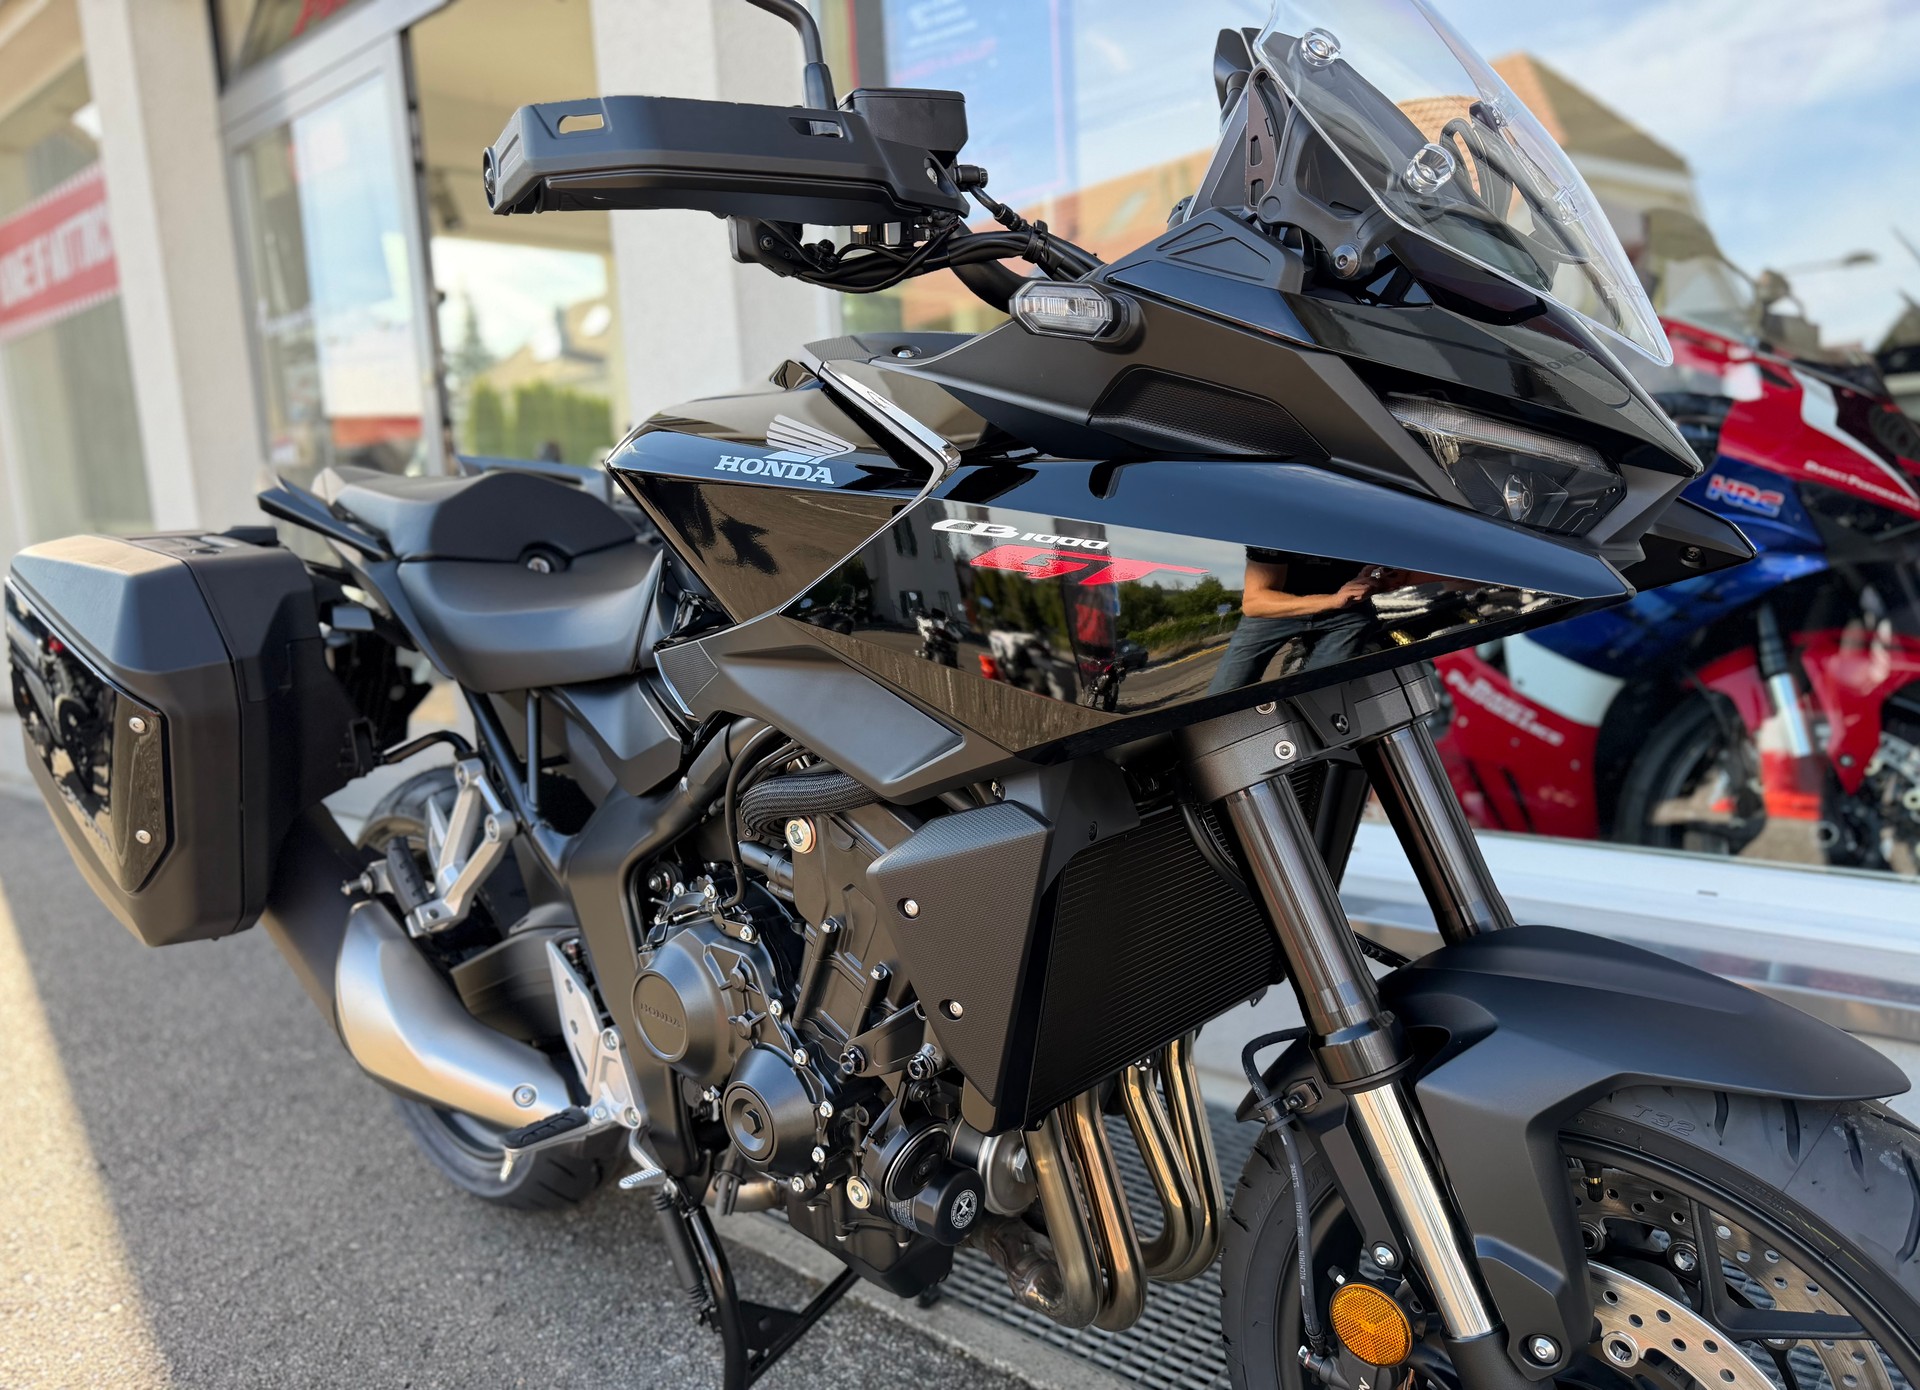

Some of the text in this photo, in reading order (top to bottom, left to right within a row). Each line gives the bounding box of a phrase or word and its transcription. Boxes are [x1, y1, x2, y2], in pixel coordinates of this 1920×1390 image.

[714, 455, 835, 485] HONDA
[1706, 474, 1785, 518] HRC
[931, 519, 1109, 550] CB 1000
[970, 544, 1210, 586] GT
[640, 1002, 683, 1031] HONDA
[1632, 1104, 1696, 1137] T32
